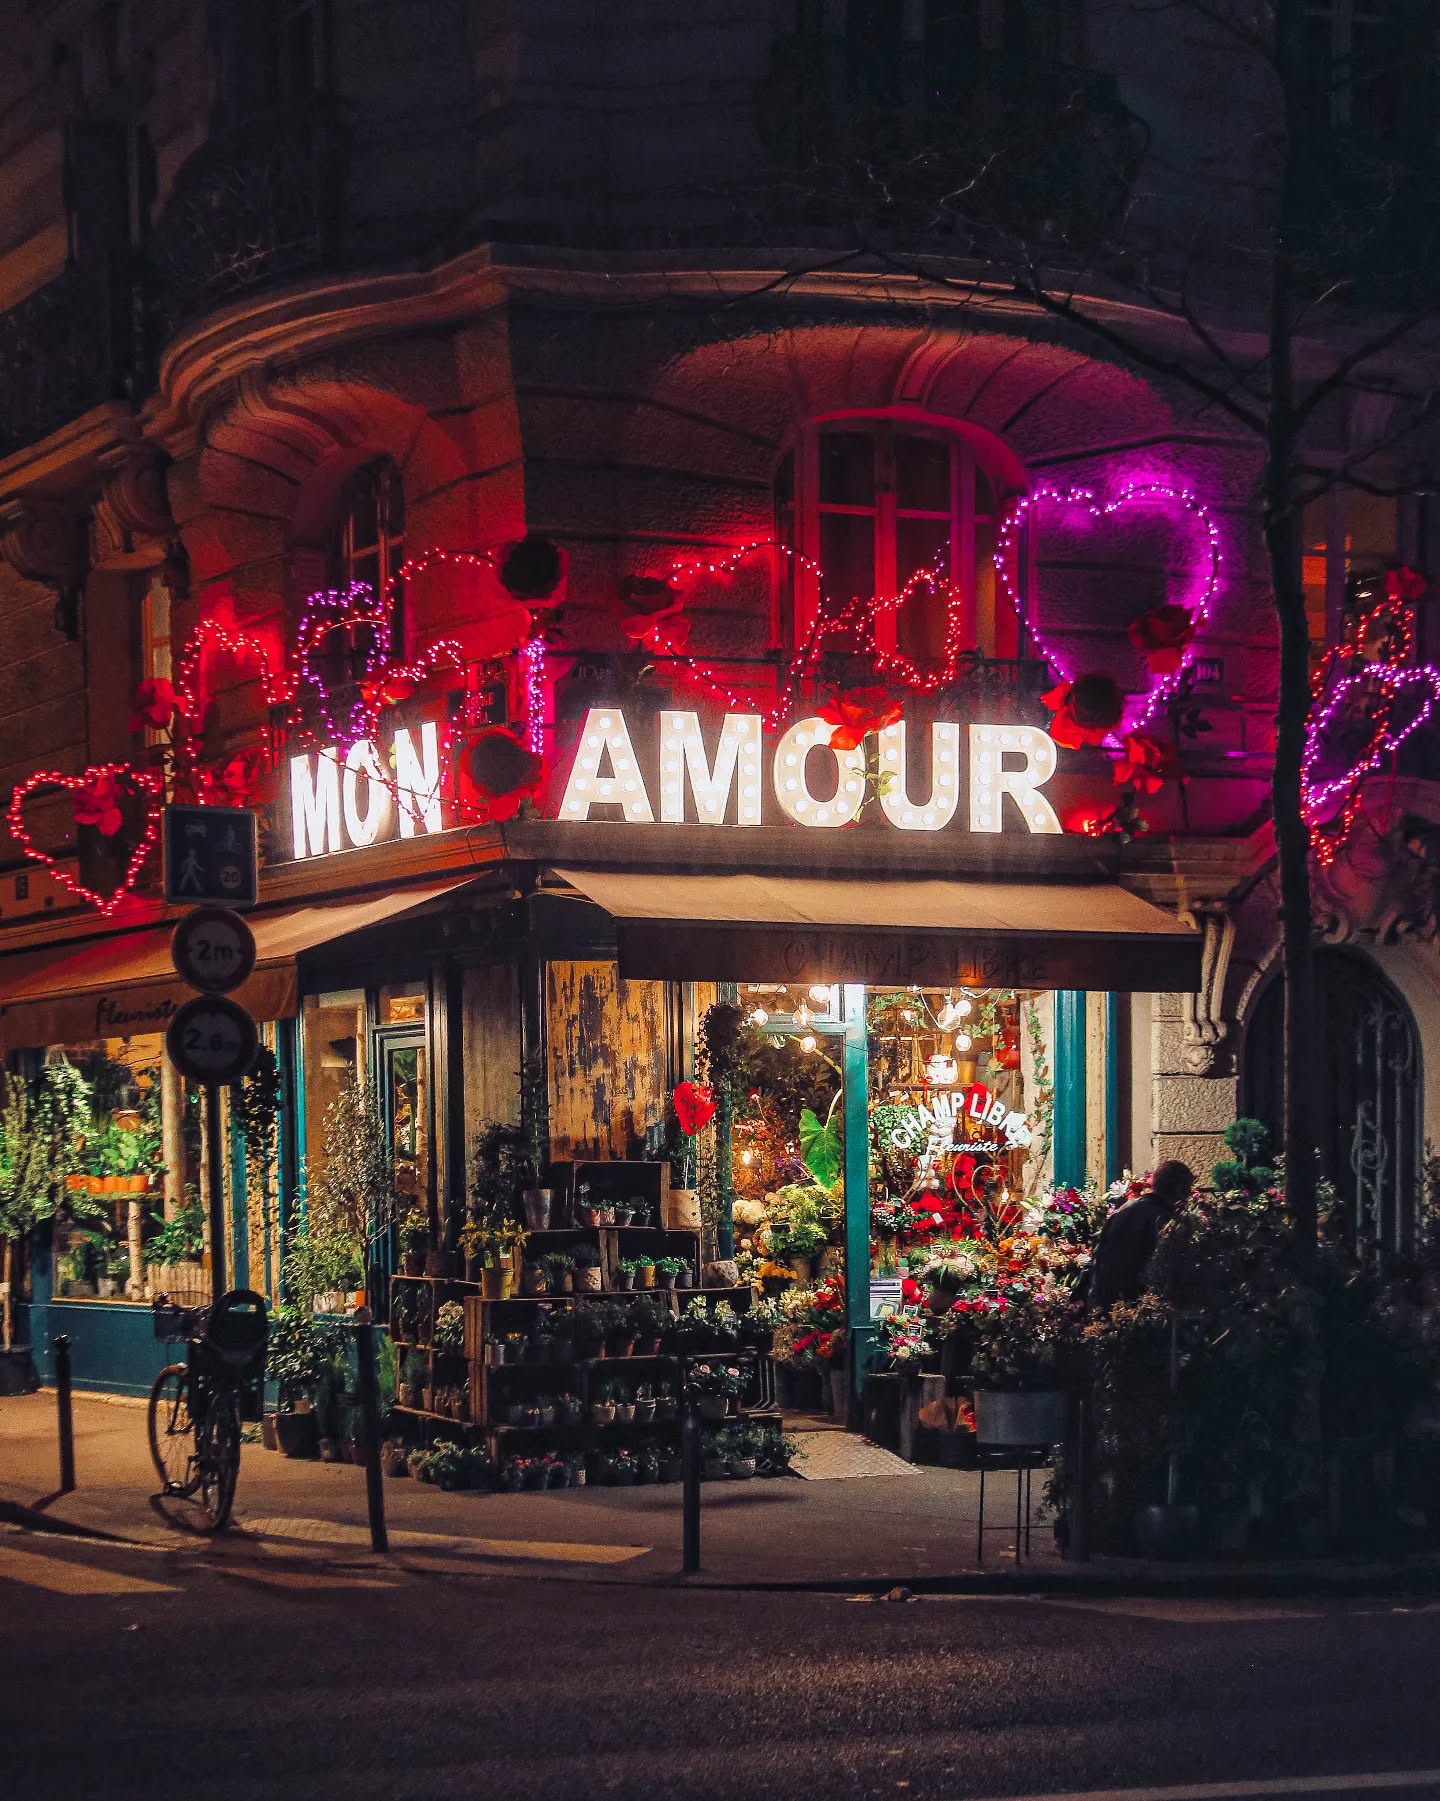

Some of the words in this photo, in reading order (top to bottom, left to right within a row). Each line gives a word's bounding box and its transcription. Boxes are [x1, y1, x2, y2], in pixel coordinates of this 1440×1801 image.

[290, 721, 443, 860] MON
[557, 708, 1064, 834] AMOUR
[890, 1092, 965, 1149] CHAMP
